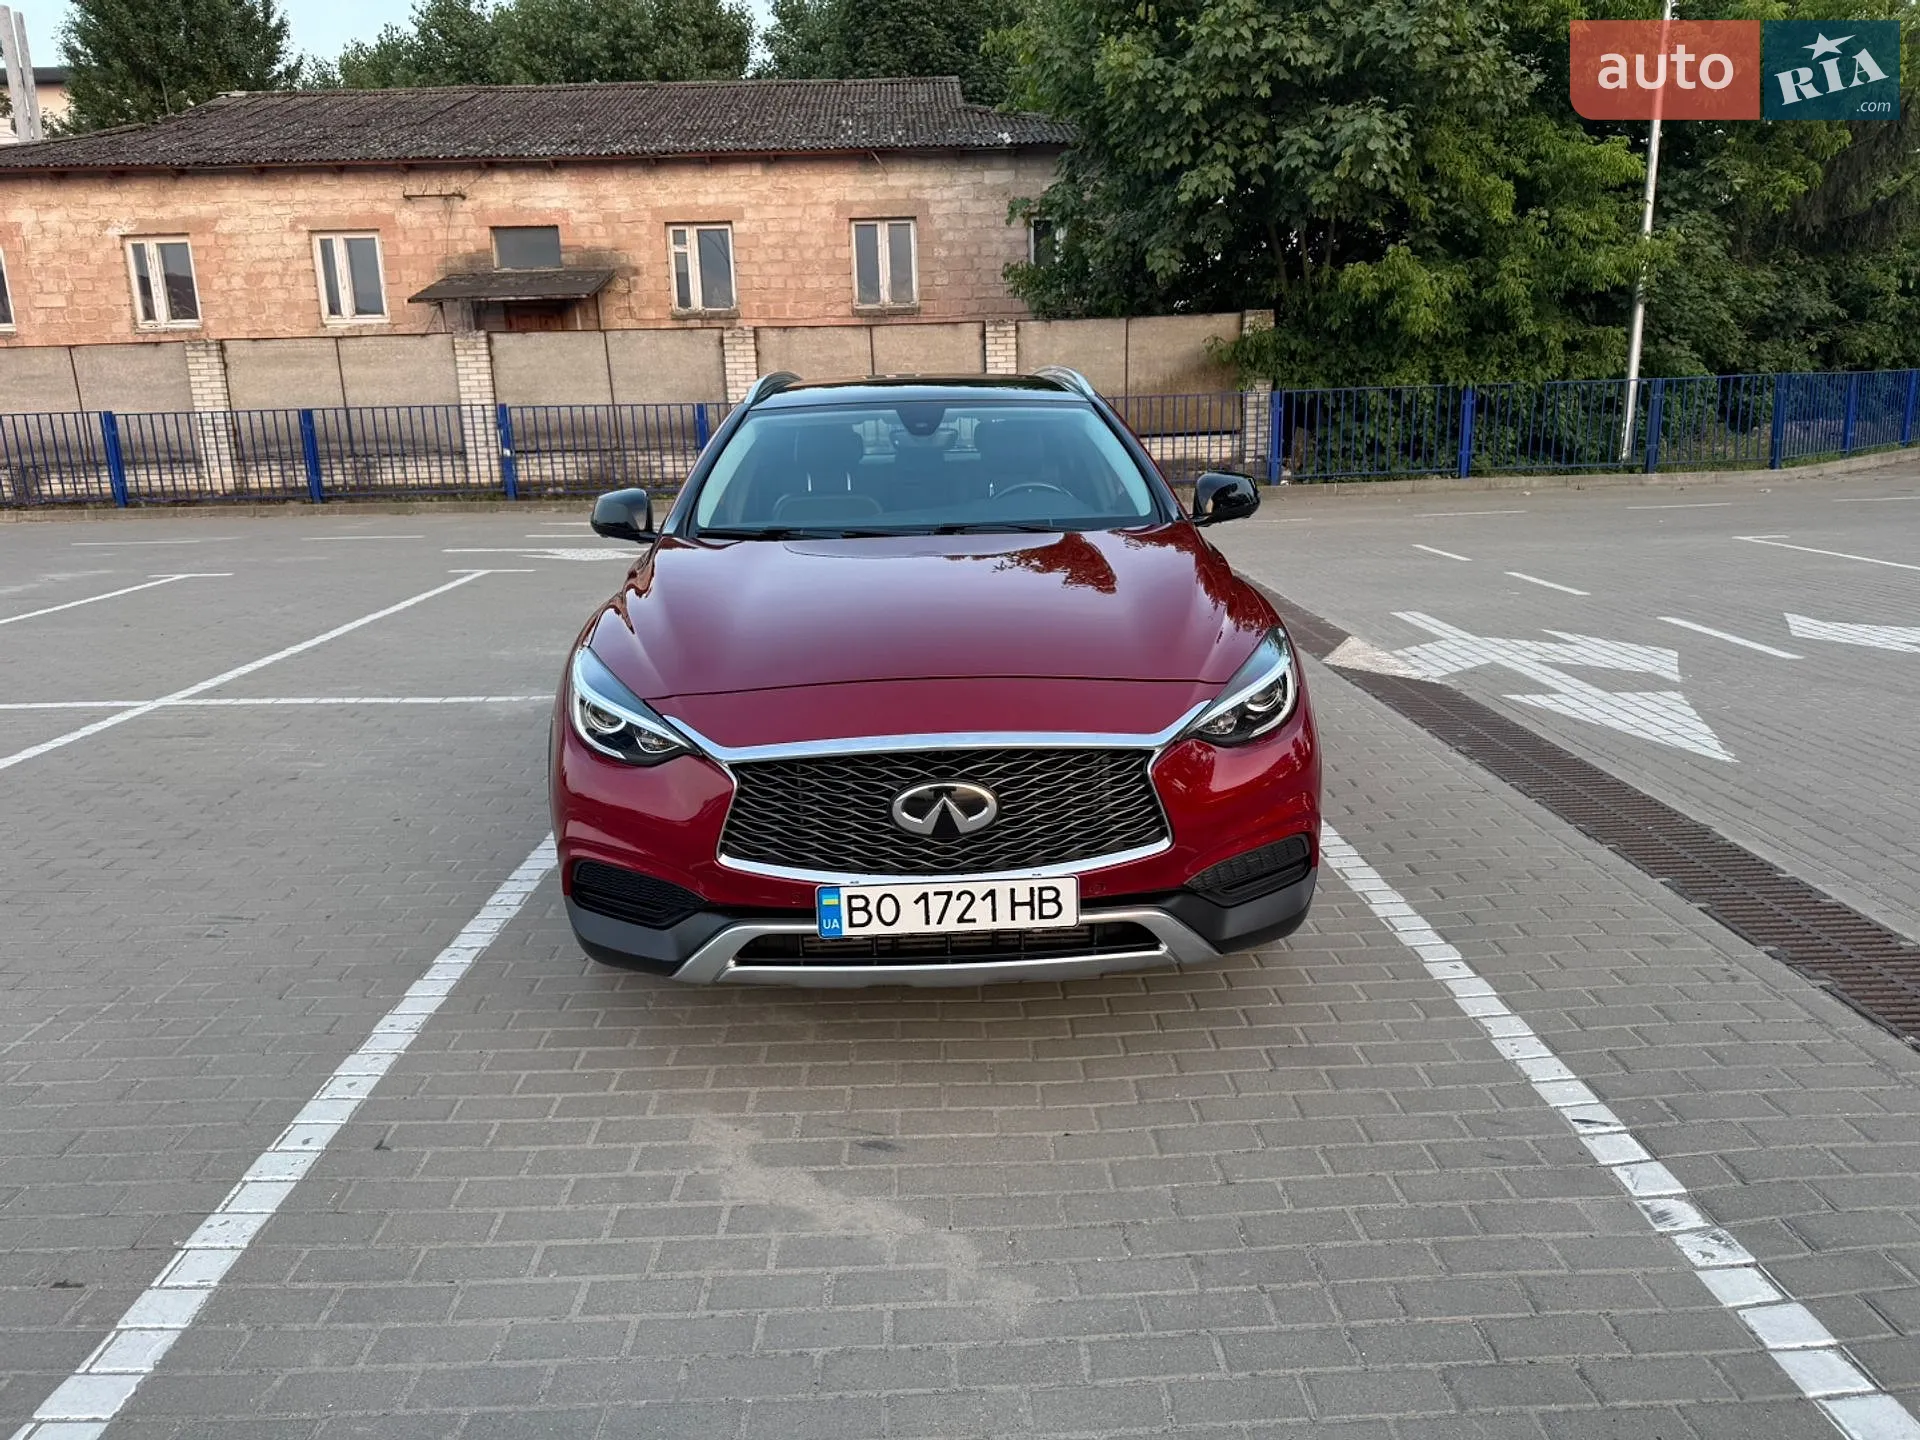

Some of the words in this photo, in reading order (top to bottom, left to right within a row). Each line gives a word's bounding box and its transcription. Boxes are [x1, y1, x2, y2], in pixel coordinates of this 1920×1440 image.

[847, 893, 900, 928] BO
[913, 888, 997, 926] 1721
[1009, 886, 1063, 921] HB
[822, 918, 840, 930] UA
